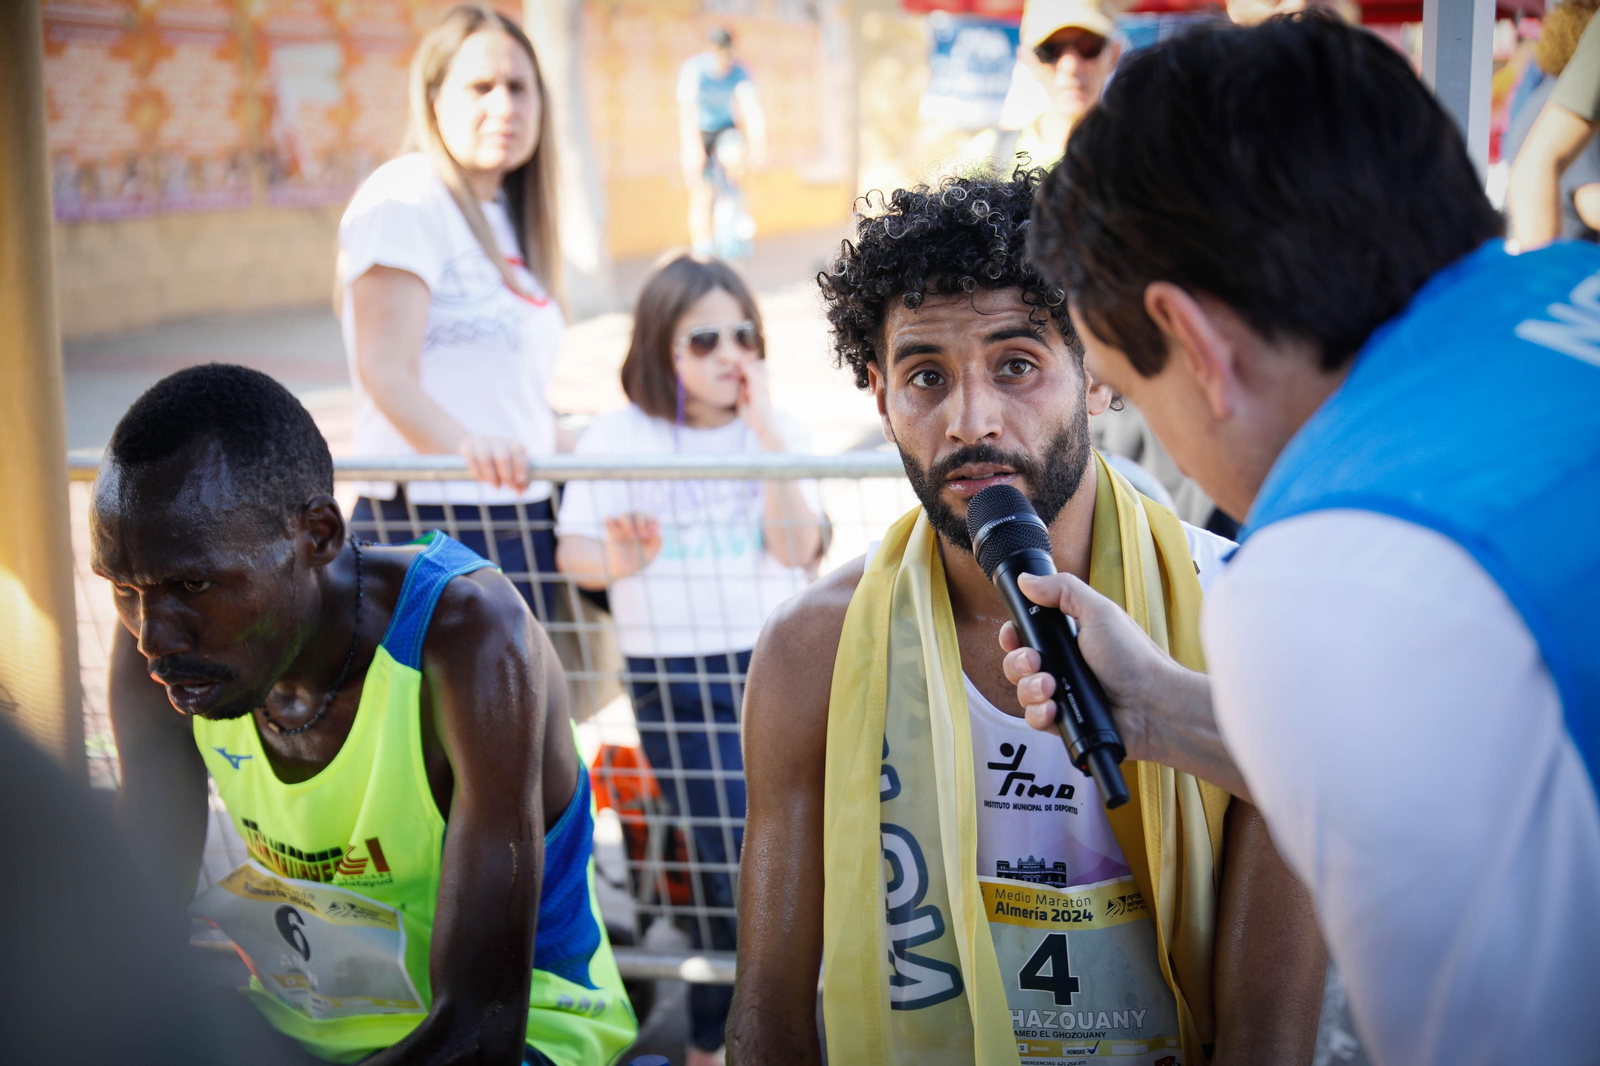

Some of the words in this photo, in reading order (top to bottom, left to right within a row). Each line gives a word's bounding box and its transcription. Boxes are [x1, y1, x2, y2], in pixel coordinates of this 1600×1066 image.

[984, 800, 1010, 810] INSTITUTO
[1012, 802, 1042, 811] MUNICIPAL
[1054, 804, 1078, 815] DEPORTES
[994, 888, 1031, 903] Medio
[1035, 893, 1092, 908] Maratón
[994, 901, 1048, 921] Almería
[1051, 908, 1094, 922] 2024
[275, 903, 311, 962] 6
[1018, 932, 1080, 1006] 4
[1009, 1008, 1148, 1030] HAZOUANY
[1013, 1030, 1037, 1038] AMED
[1052, 1031, 1107, 1039] GHOZOUANY
